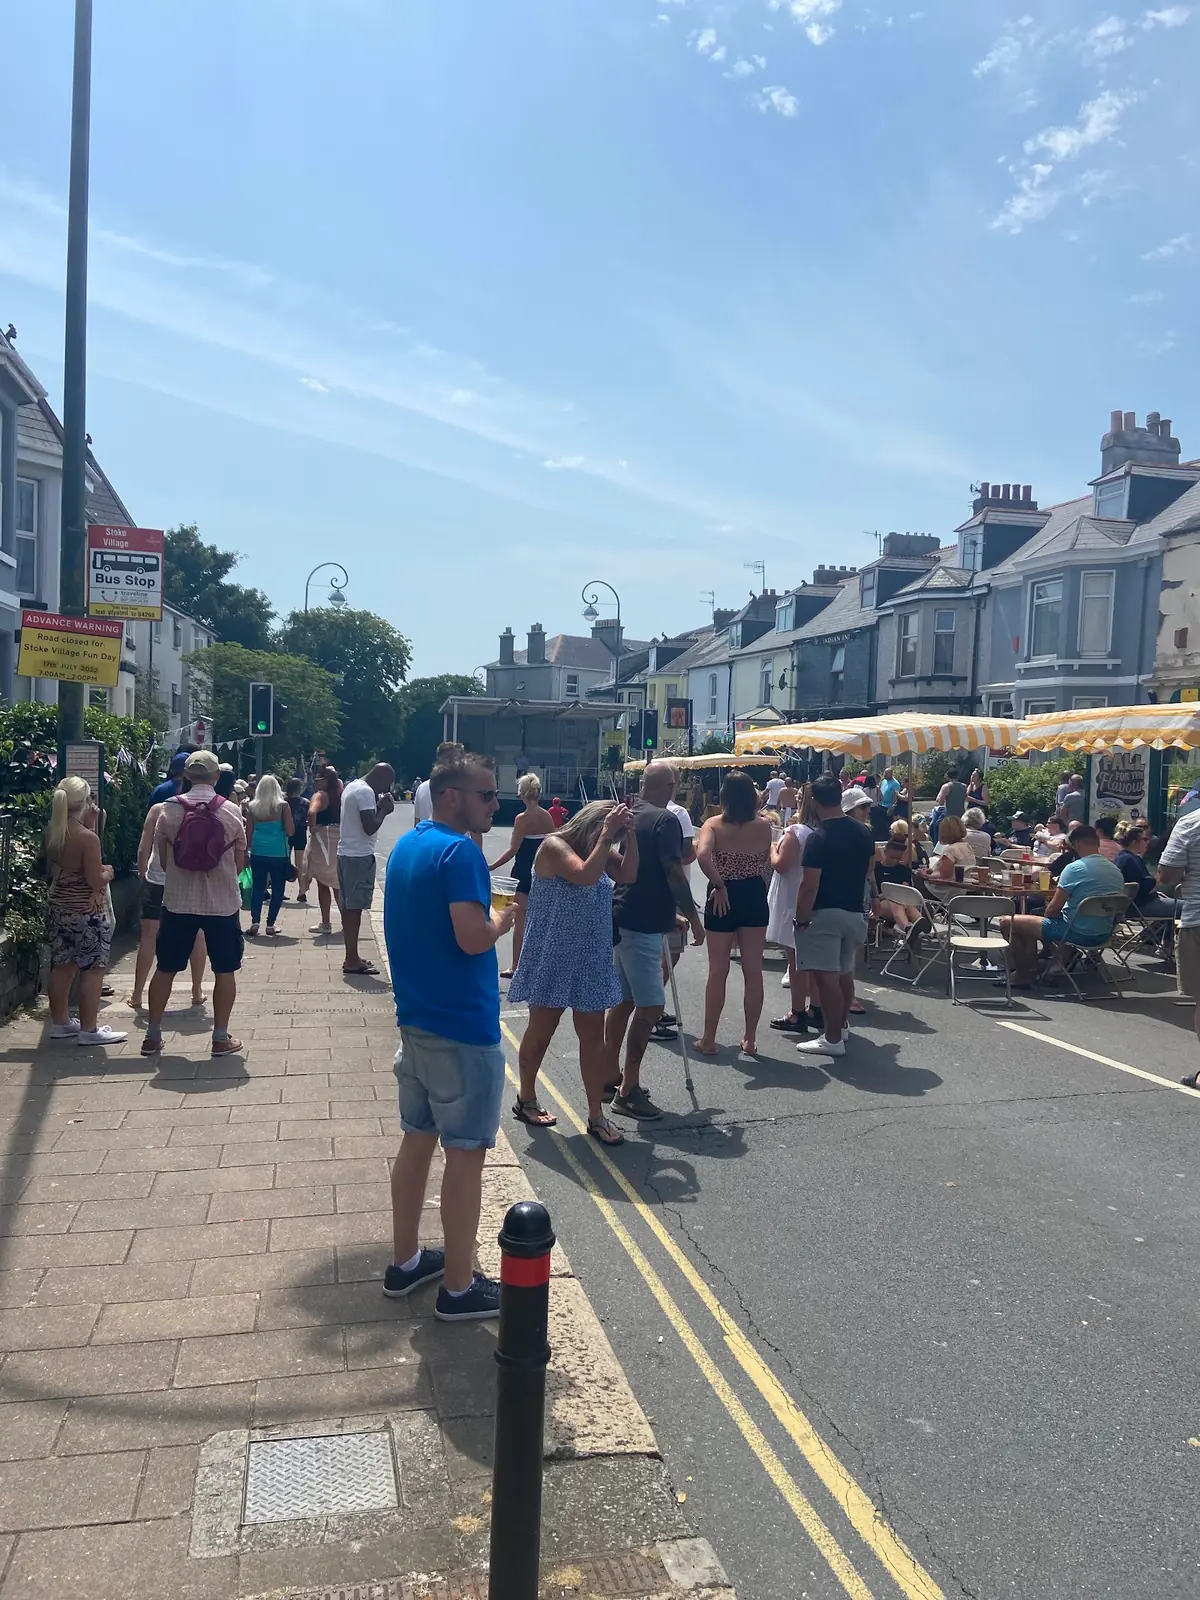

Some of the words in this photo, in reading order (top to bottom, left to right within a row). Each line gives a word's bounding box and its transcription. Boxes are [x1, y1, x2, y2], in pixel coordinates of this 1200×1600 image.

[106, 527, 126, 536] Stoke
[103, 538, 129, 548] Village
[96, 573, 120, 584] Bus
[125, 574, 155, 589] Stop
[26, 614, 72, 628] ADVANCE
[74, 621, 119, 633] WARNING
[38, 633, 59, 642] Road
[62, 636, 88, 646] closed
[24, 644, 48, 652] Stoke
[52, 646, 80, 658] Village
[101, 653, 116, 662] Day
[60, 662, 78, 670] JULY
[1101, 753, 1145, 771] FALL
[1098, 771, 1143, 794] Flavour
[1115, 771, 1130, 781] FOR
[1131, 771, 1144, 780] THE
